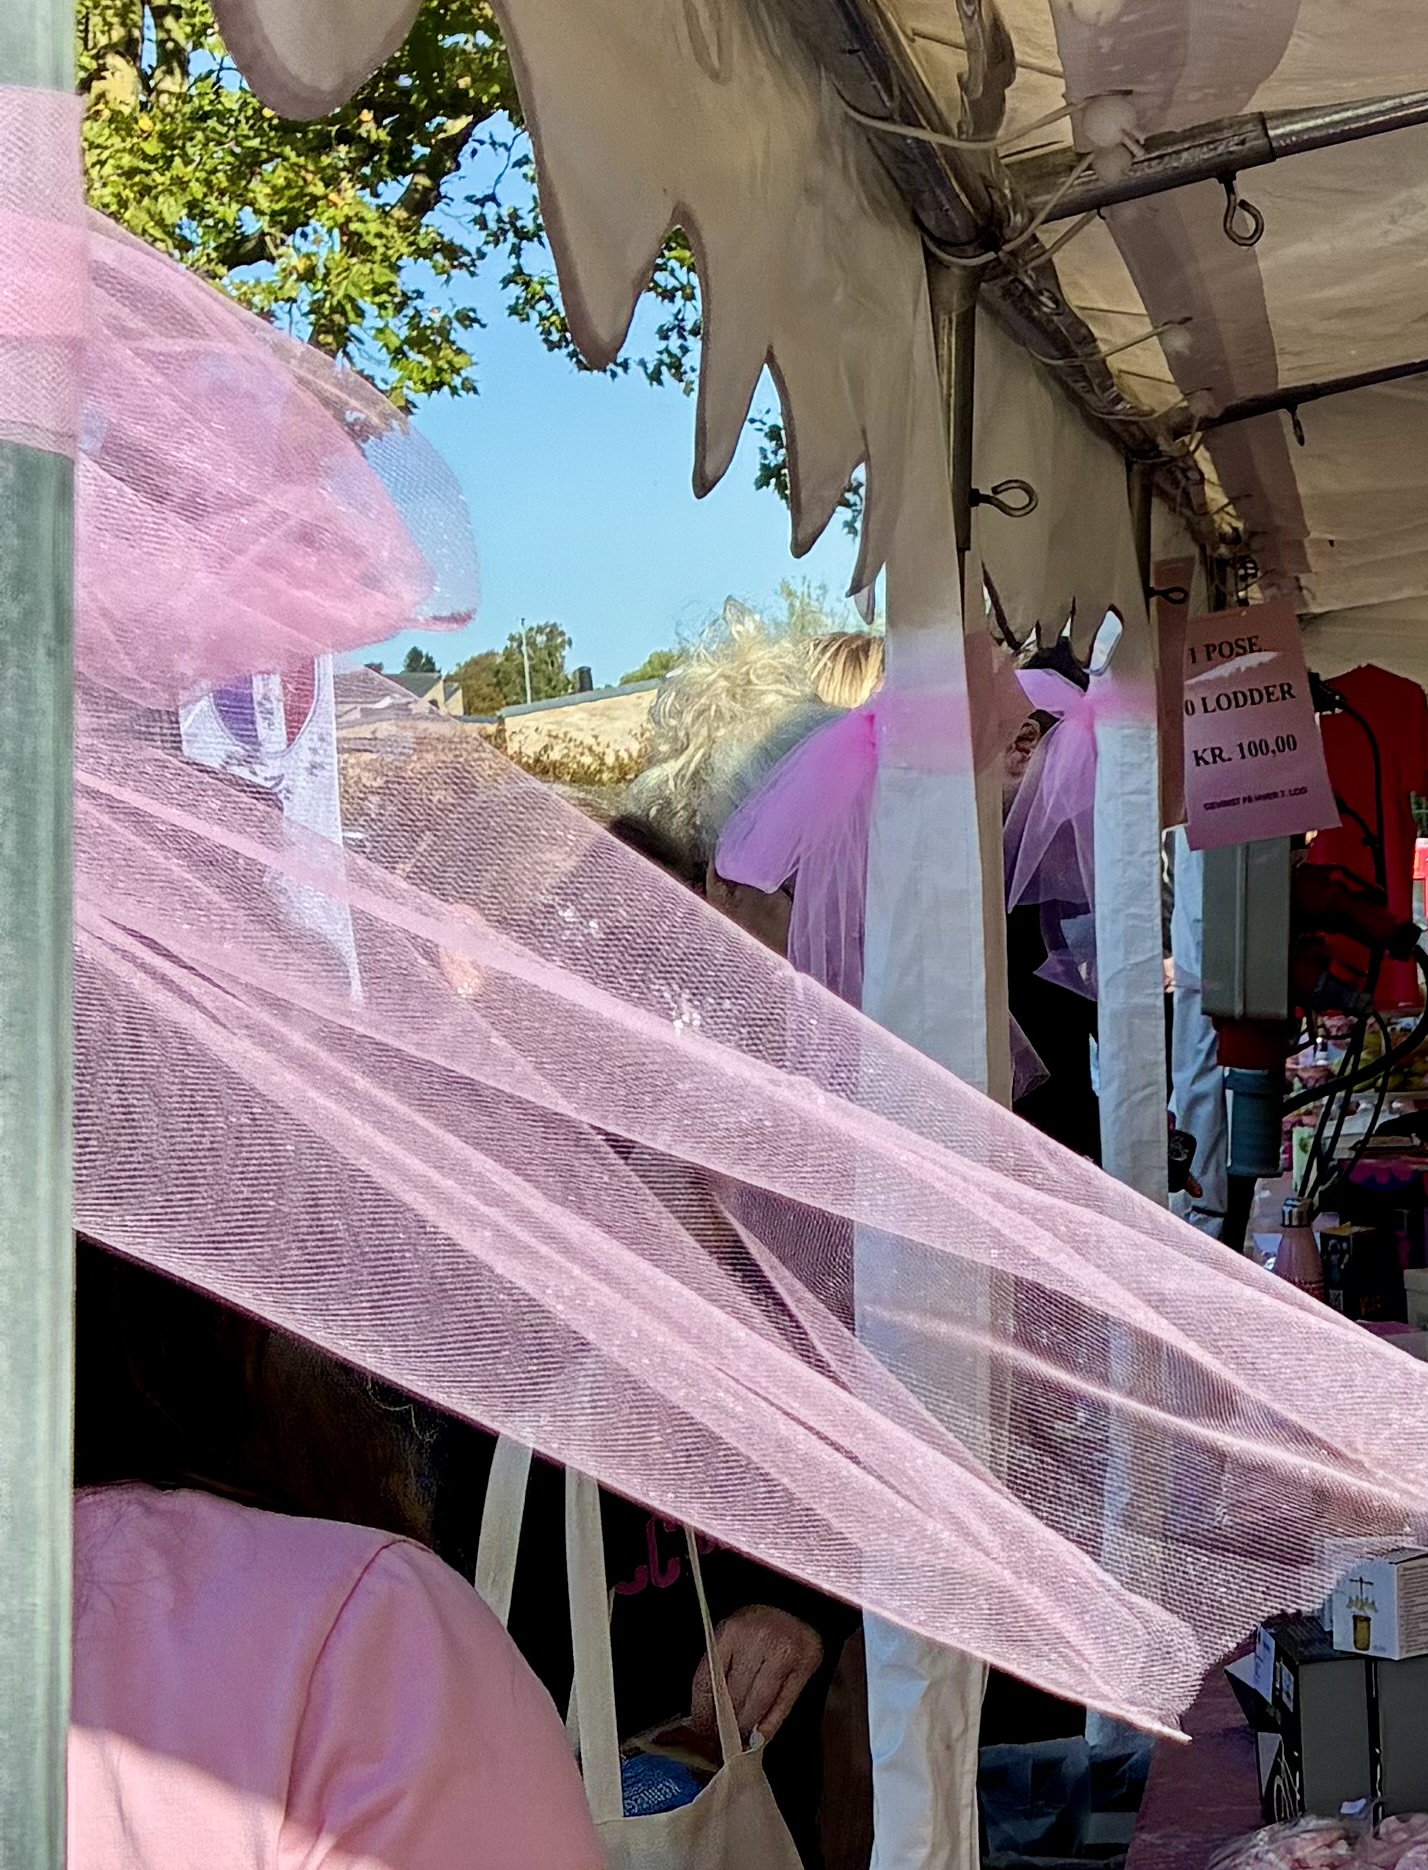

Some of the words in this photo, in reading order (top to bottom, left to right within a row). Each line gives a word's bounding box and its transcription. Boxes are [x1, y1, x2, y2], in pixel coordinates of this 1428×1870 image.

[1188, 647, 1197, 664] 1
[1204, 635, 1262, 662] POSE
[1184, 700, 1195, 716] 0
[1201, 682, 1296, 714] LODDER
[1192, 746, 1232, 767] KR.
[1236, 734, 1298, 760] 100,00
